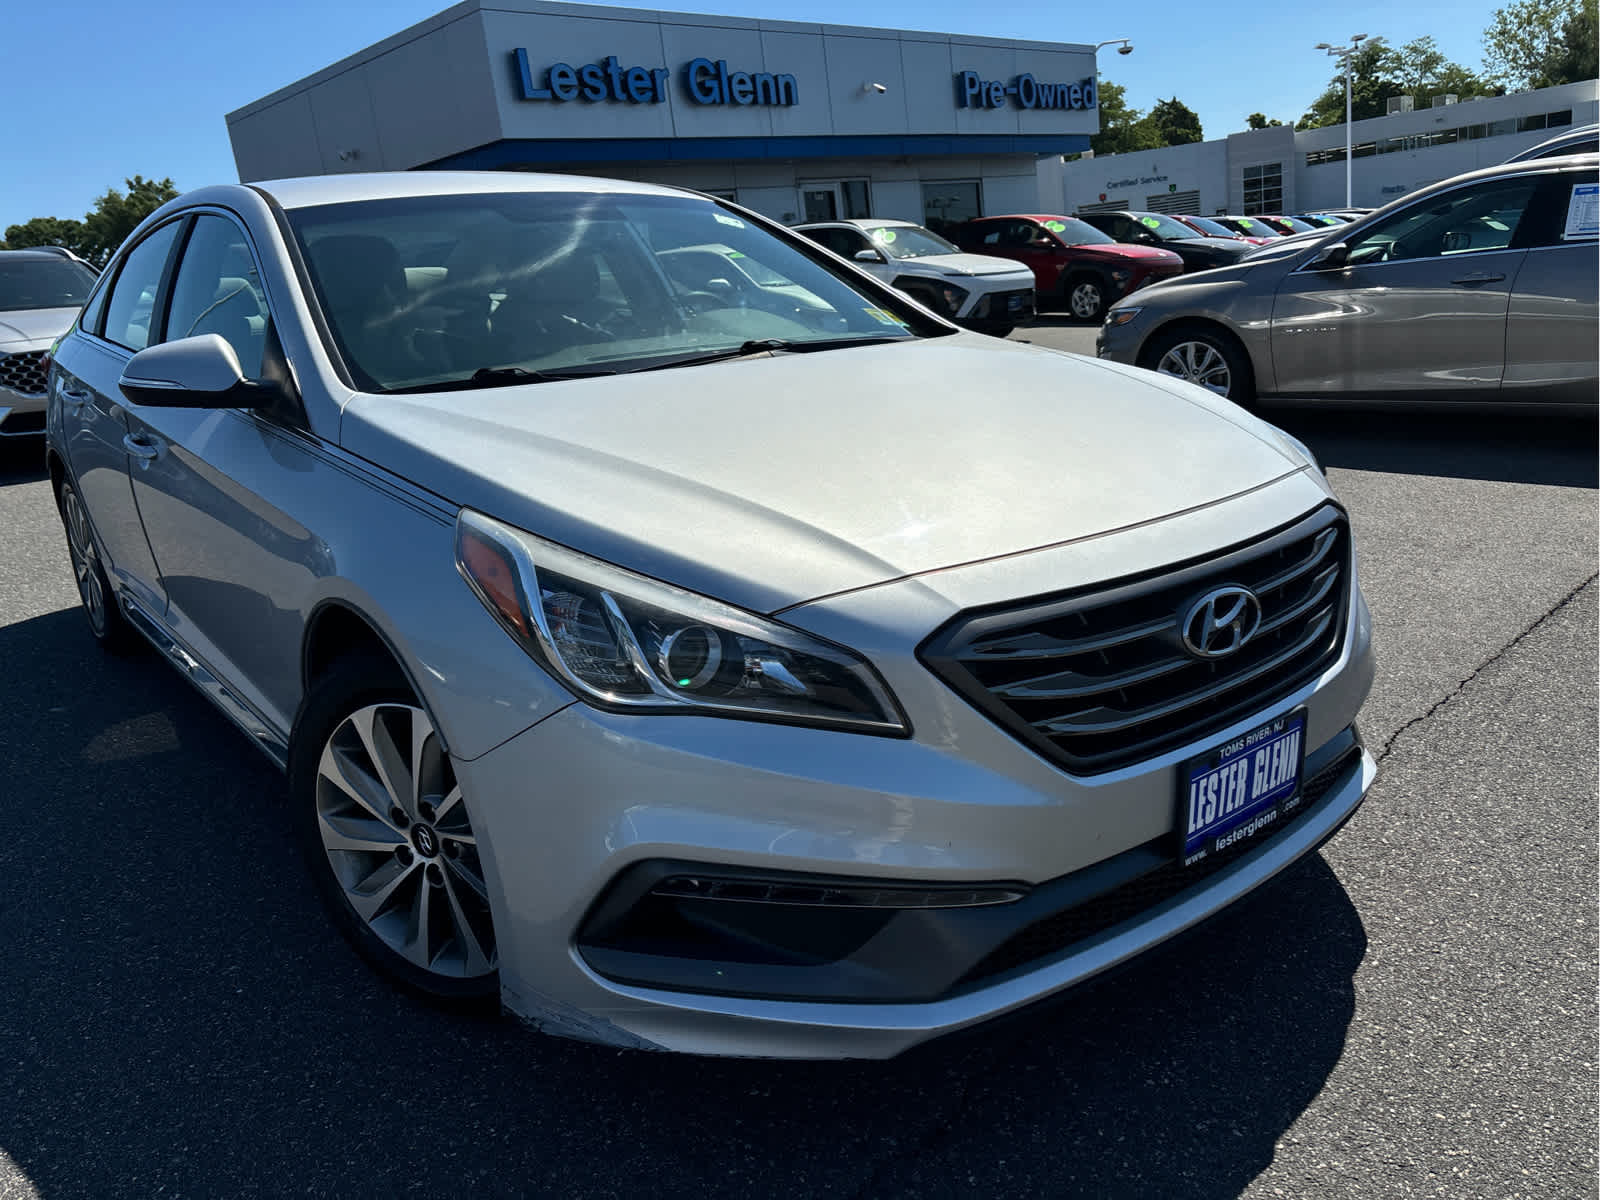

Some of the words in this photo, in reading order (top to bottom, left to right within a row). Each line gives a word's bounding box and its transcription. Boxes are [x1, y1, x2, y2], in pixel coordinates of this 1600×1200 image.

[512, 47, 669, 101] Lester
[686, 57, 799, 105] Glenn
[960, 70, 1096, 110] Pre-Owned
[1219, 739, 1245, 759] TOMS
[1274, 719, 1285, 732] NJ
[1188, 757, 1249, 835] LESTER
[1251, 730, 1300, 800] GLENN
[1215, 809, 1277, 851] lesterglenn
